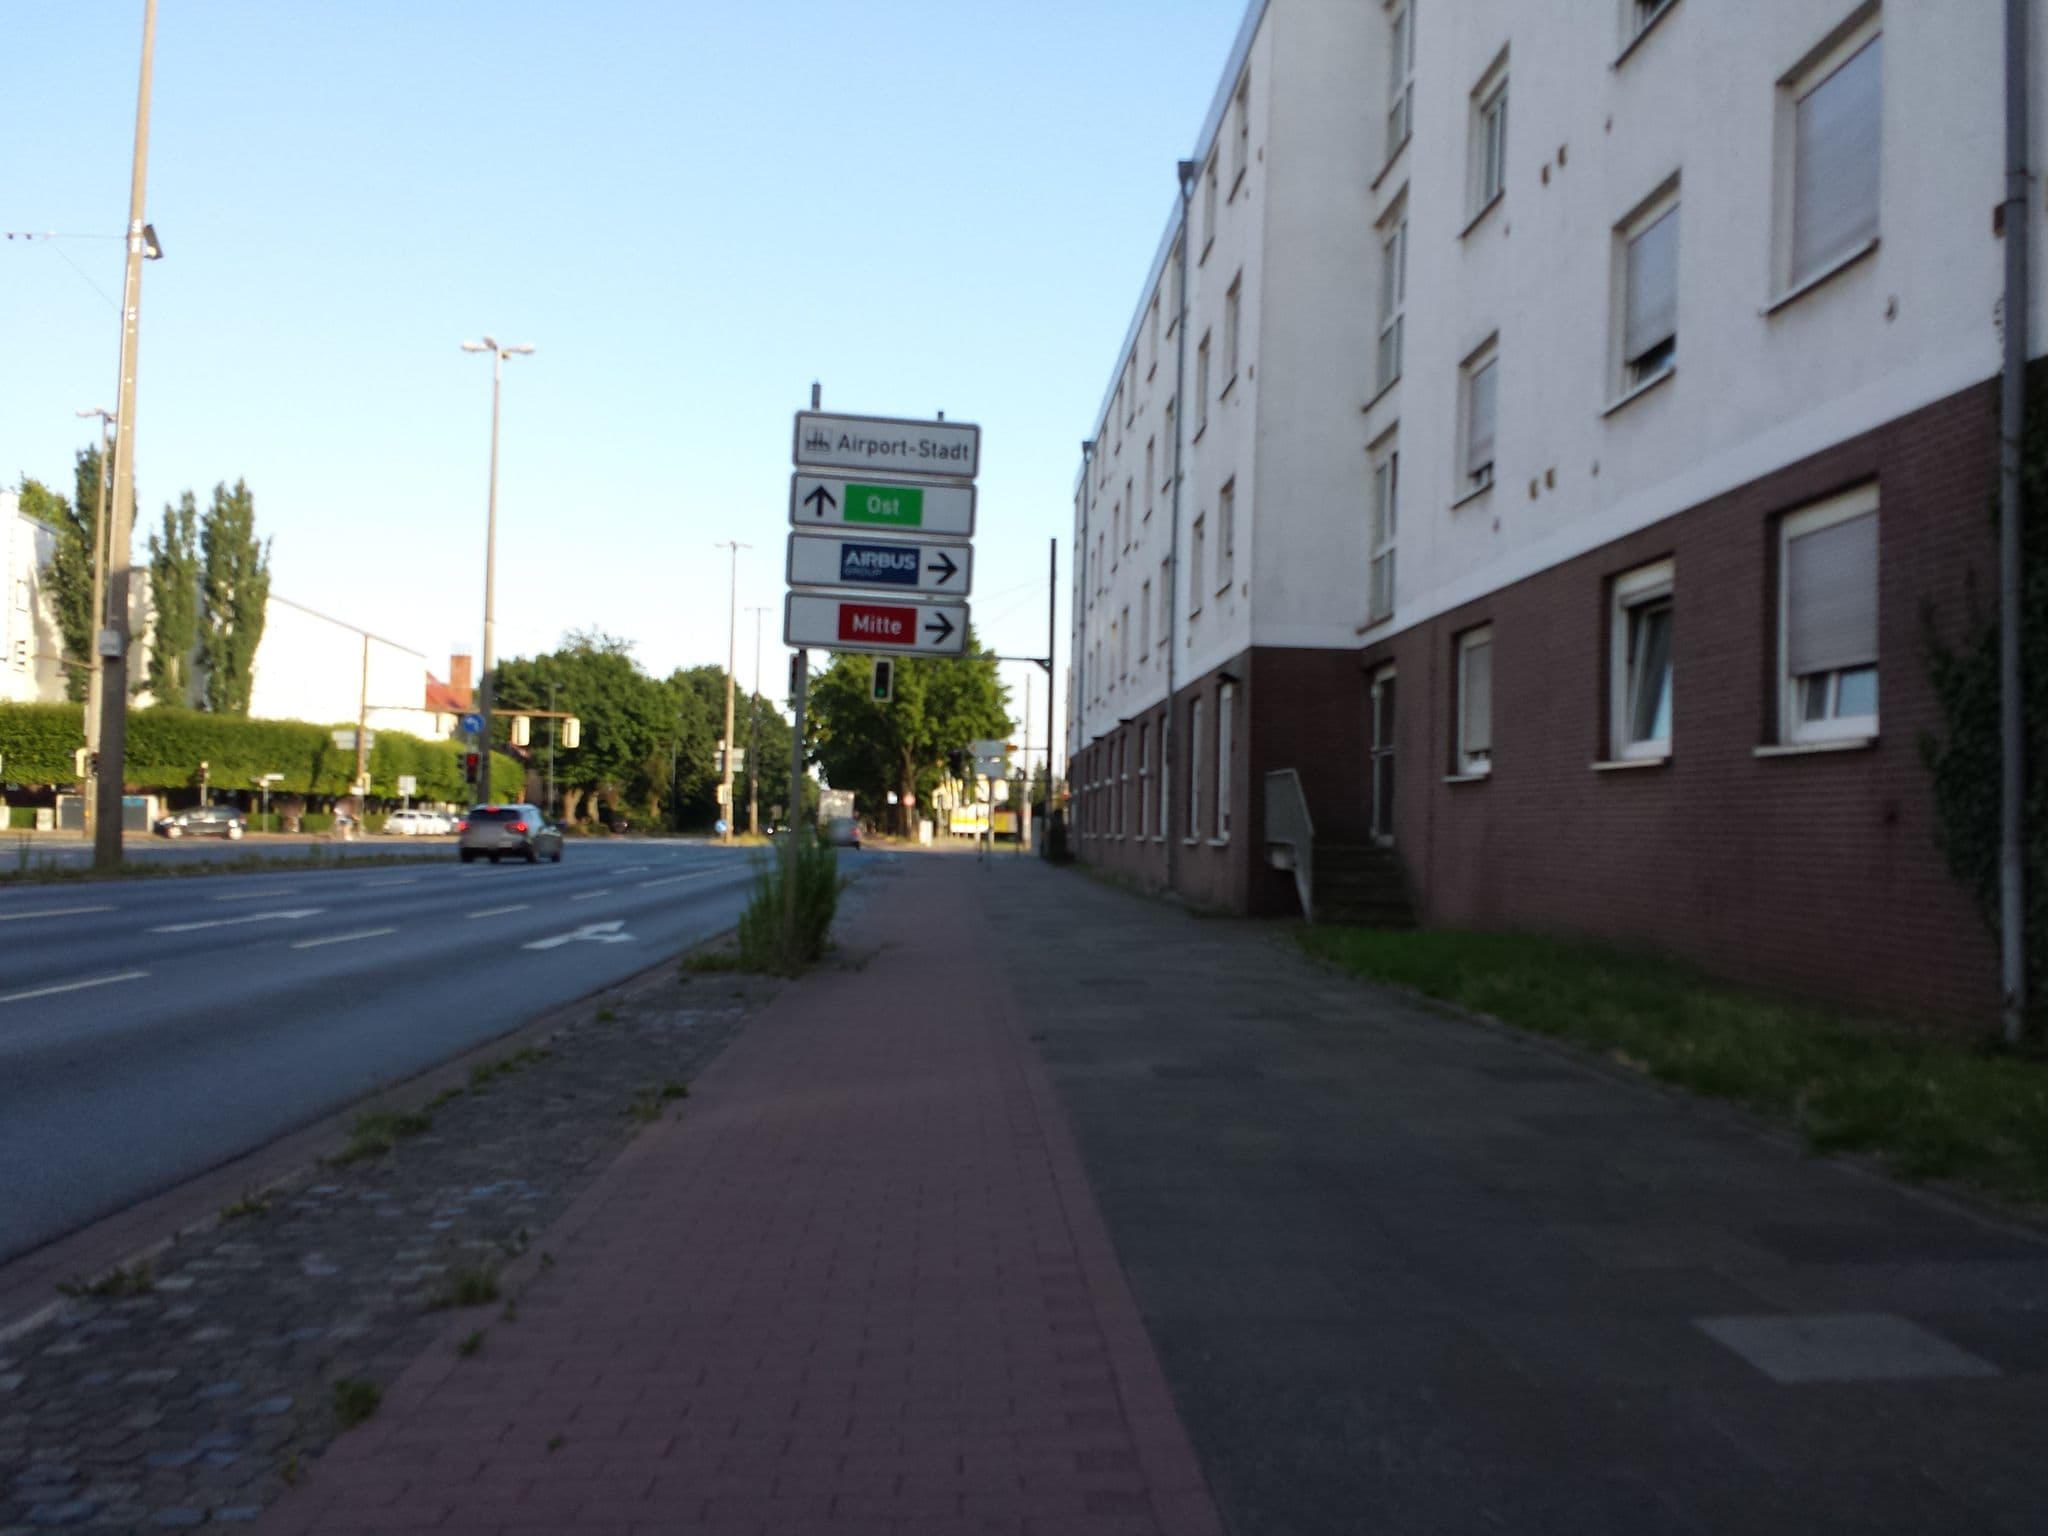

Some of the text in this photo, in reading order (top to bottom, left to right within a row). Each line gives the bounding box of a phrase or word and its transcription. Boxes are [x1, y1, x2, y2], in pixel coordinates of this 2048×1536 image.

[837, 434, 969, 461] Airport-Stadt
[867, 495, 900, 515] Ost
[845, 551, 916, 570] AIRBUS
[852, 615, 902, 635] Mitte
